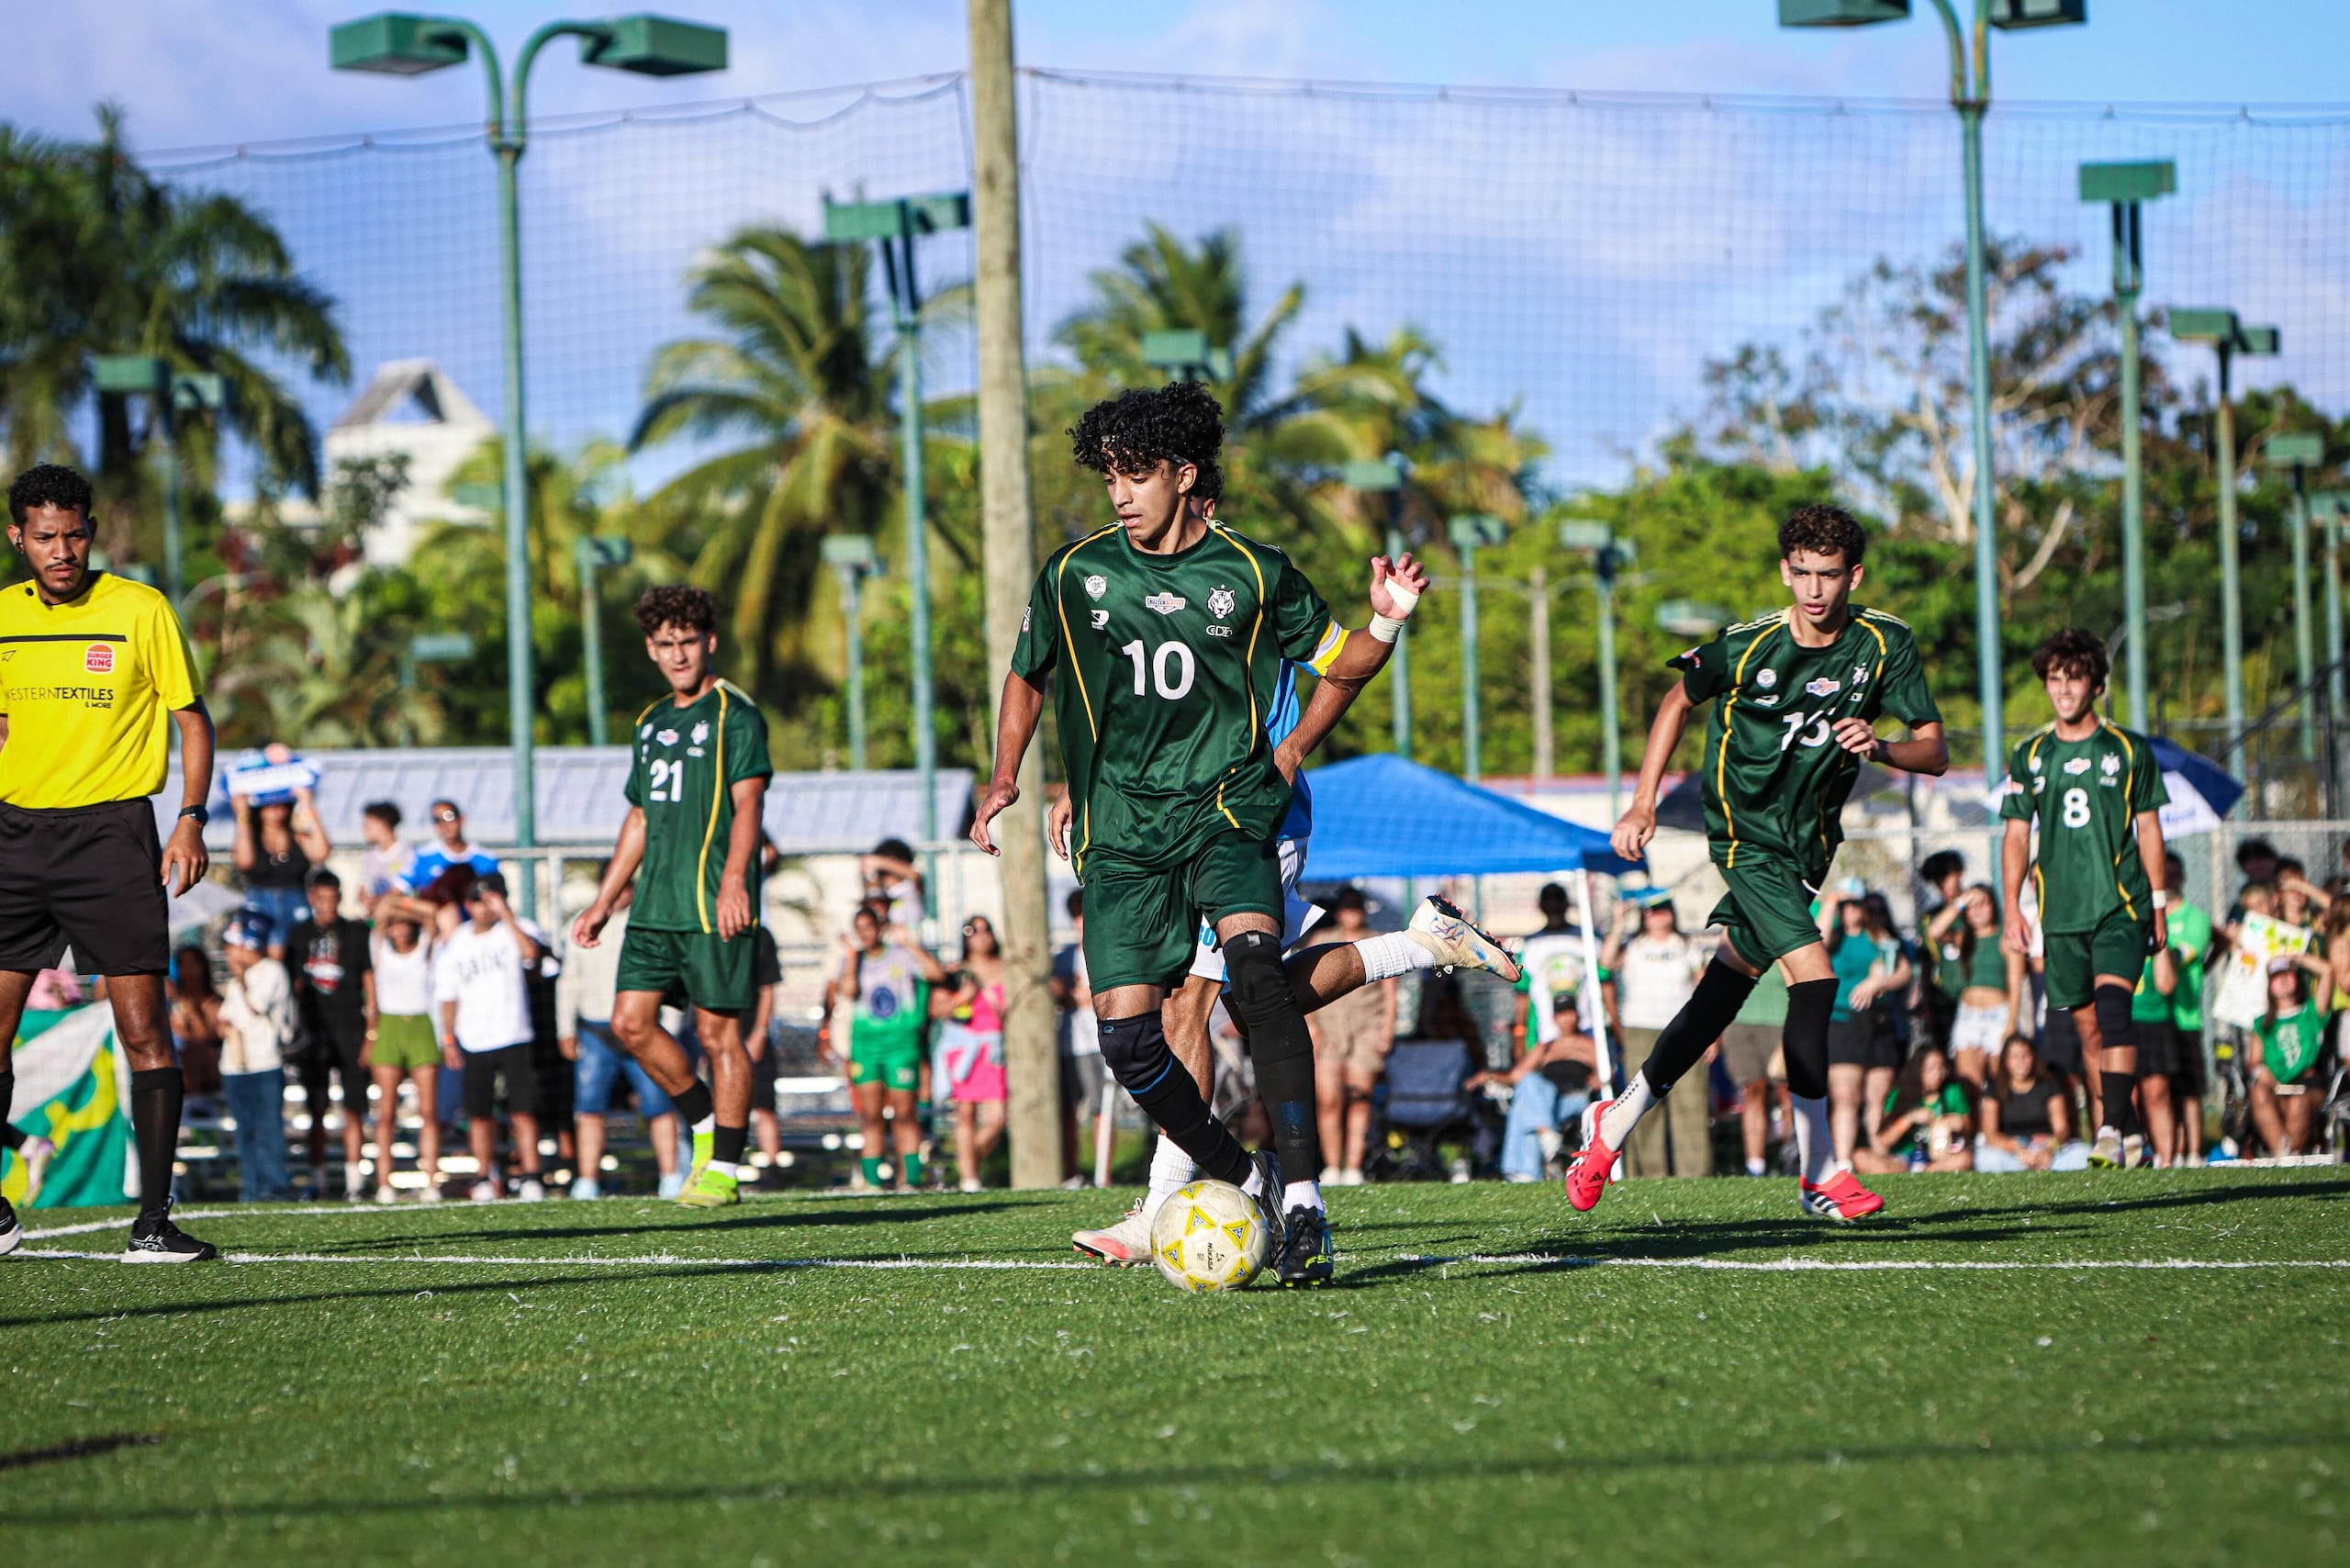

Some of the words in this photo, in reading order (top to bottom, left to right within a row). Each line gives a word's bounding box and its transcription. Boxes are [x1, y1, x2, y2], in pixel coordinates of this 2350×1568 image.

[86, 659, 112, 667] KING
[1122, 639, 1195, 700] 10
[649, 758, 683, 802] 21
[2063, 787, 2091, 829] 8
